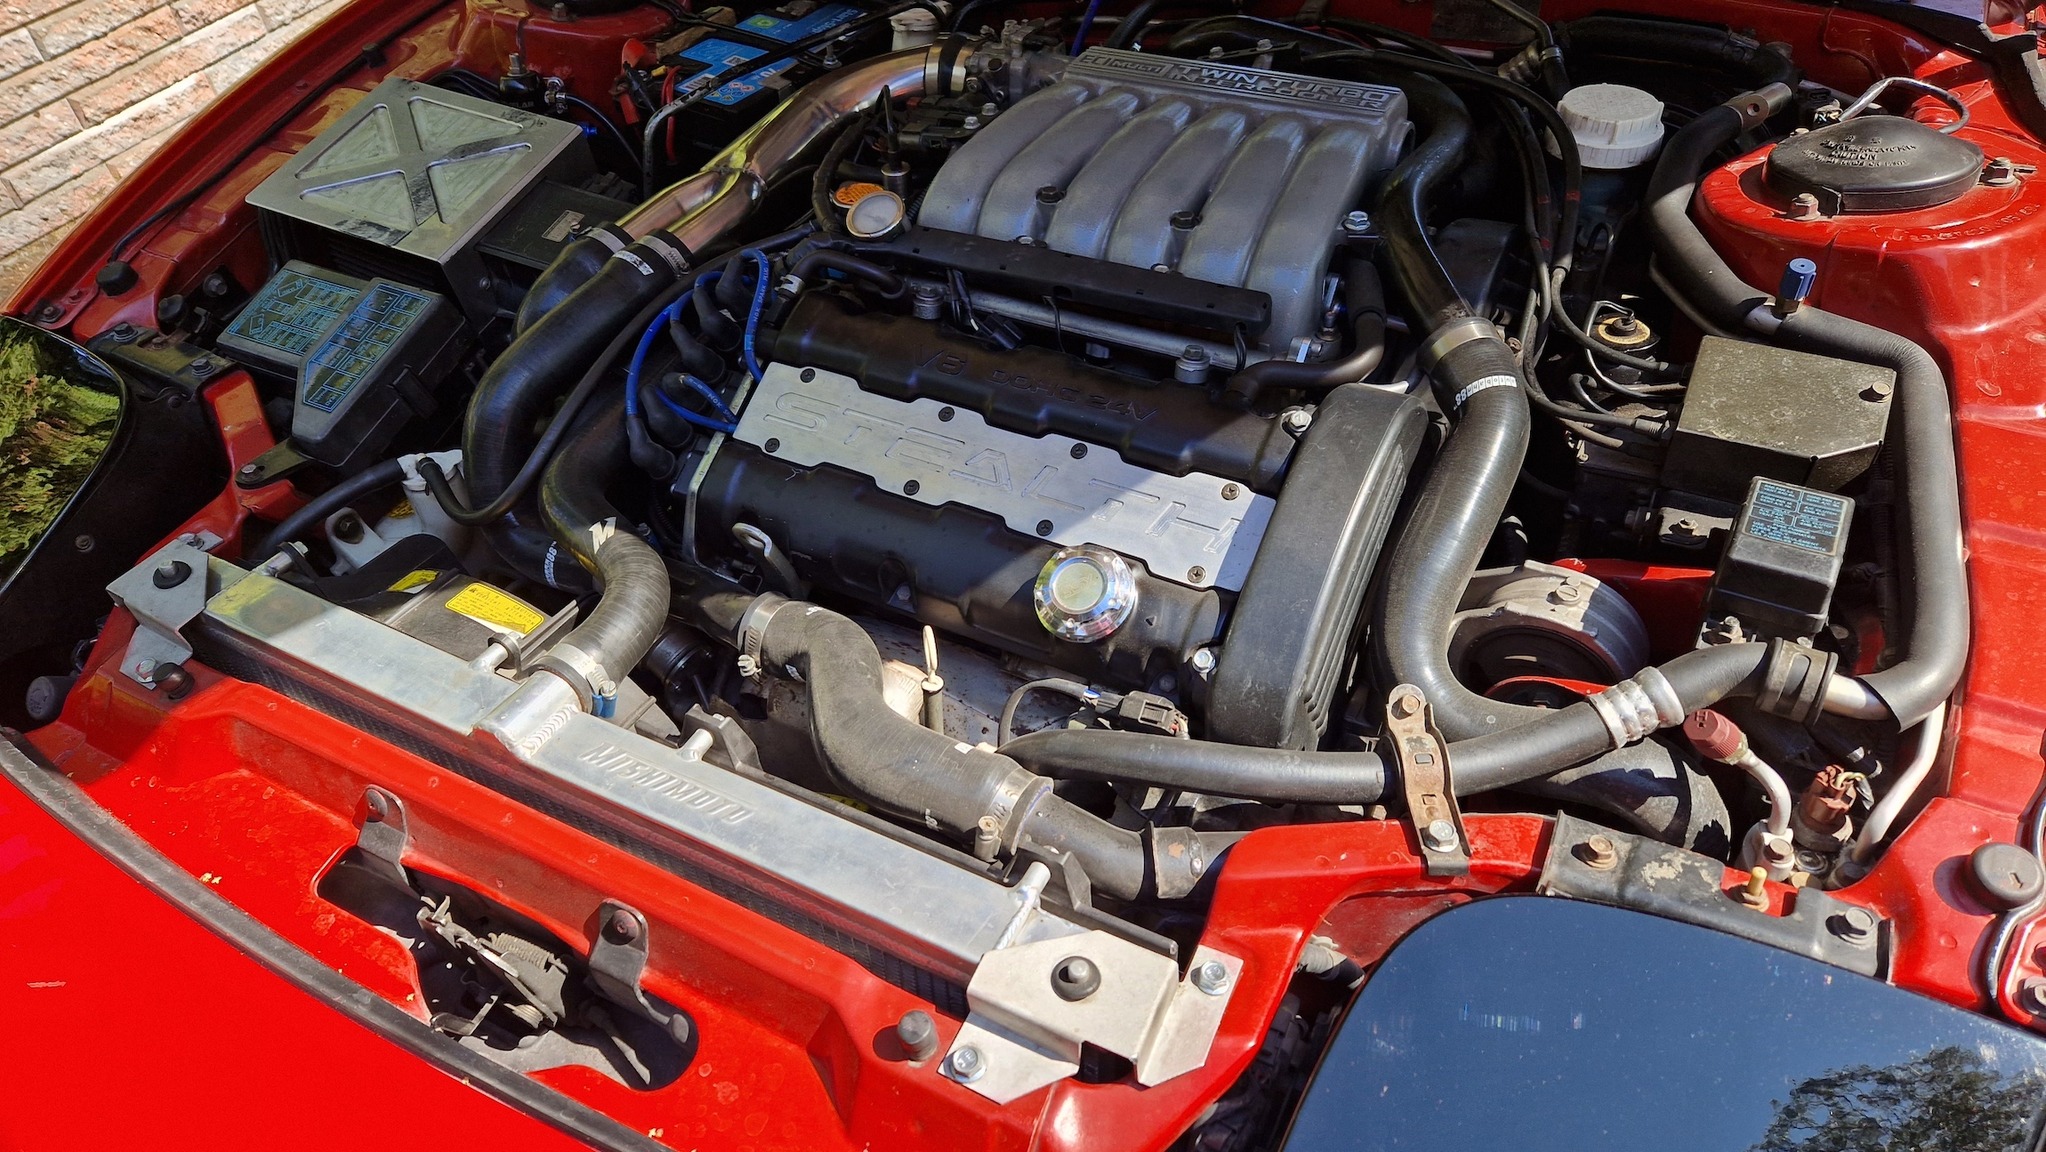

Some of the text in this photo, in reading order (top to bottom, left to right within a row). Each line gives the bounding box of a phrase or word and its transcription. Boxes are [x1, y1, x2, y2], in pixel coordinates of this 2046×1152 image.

[1112, 60, 1163, 73] MULTI
[1178, 64, 1391, 102] TWIN TURBO
[1169, 72, 1383, 109] INTERCOOLER
[985, 370, 1079, 402] DOHC
[1089, 394, 1158, 421] 24V
[762, 391, 1245, 554] STEALTH
[576, 742, 755, 825] MISHIMOTO
